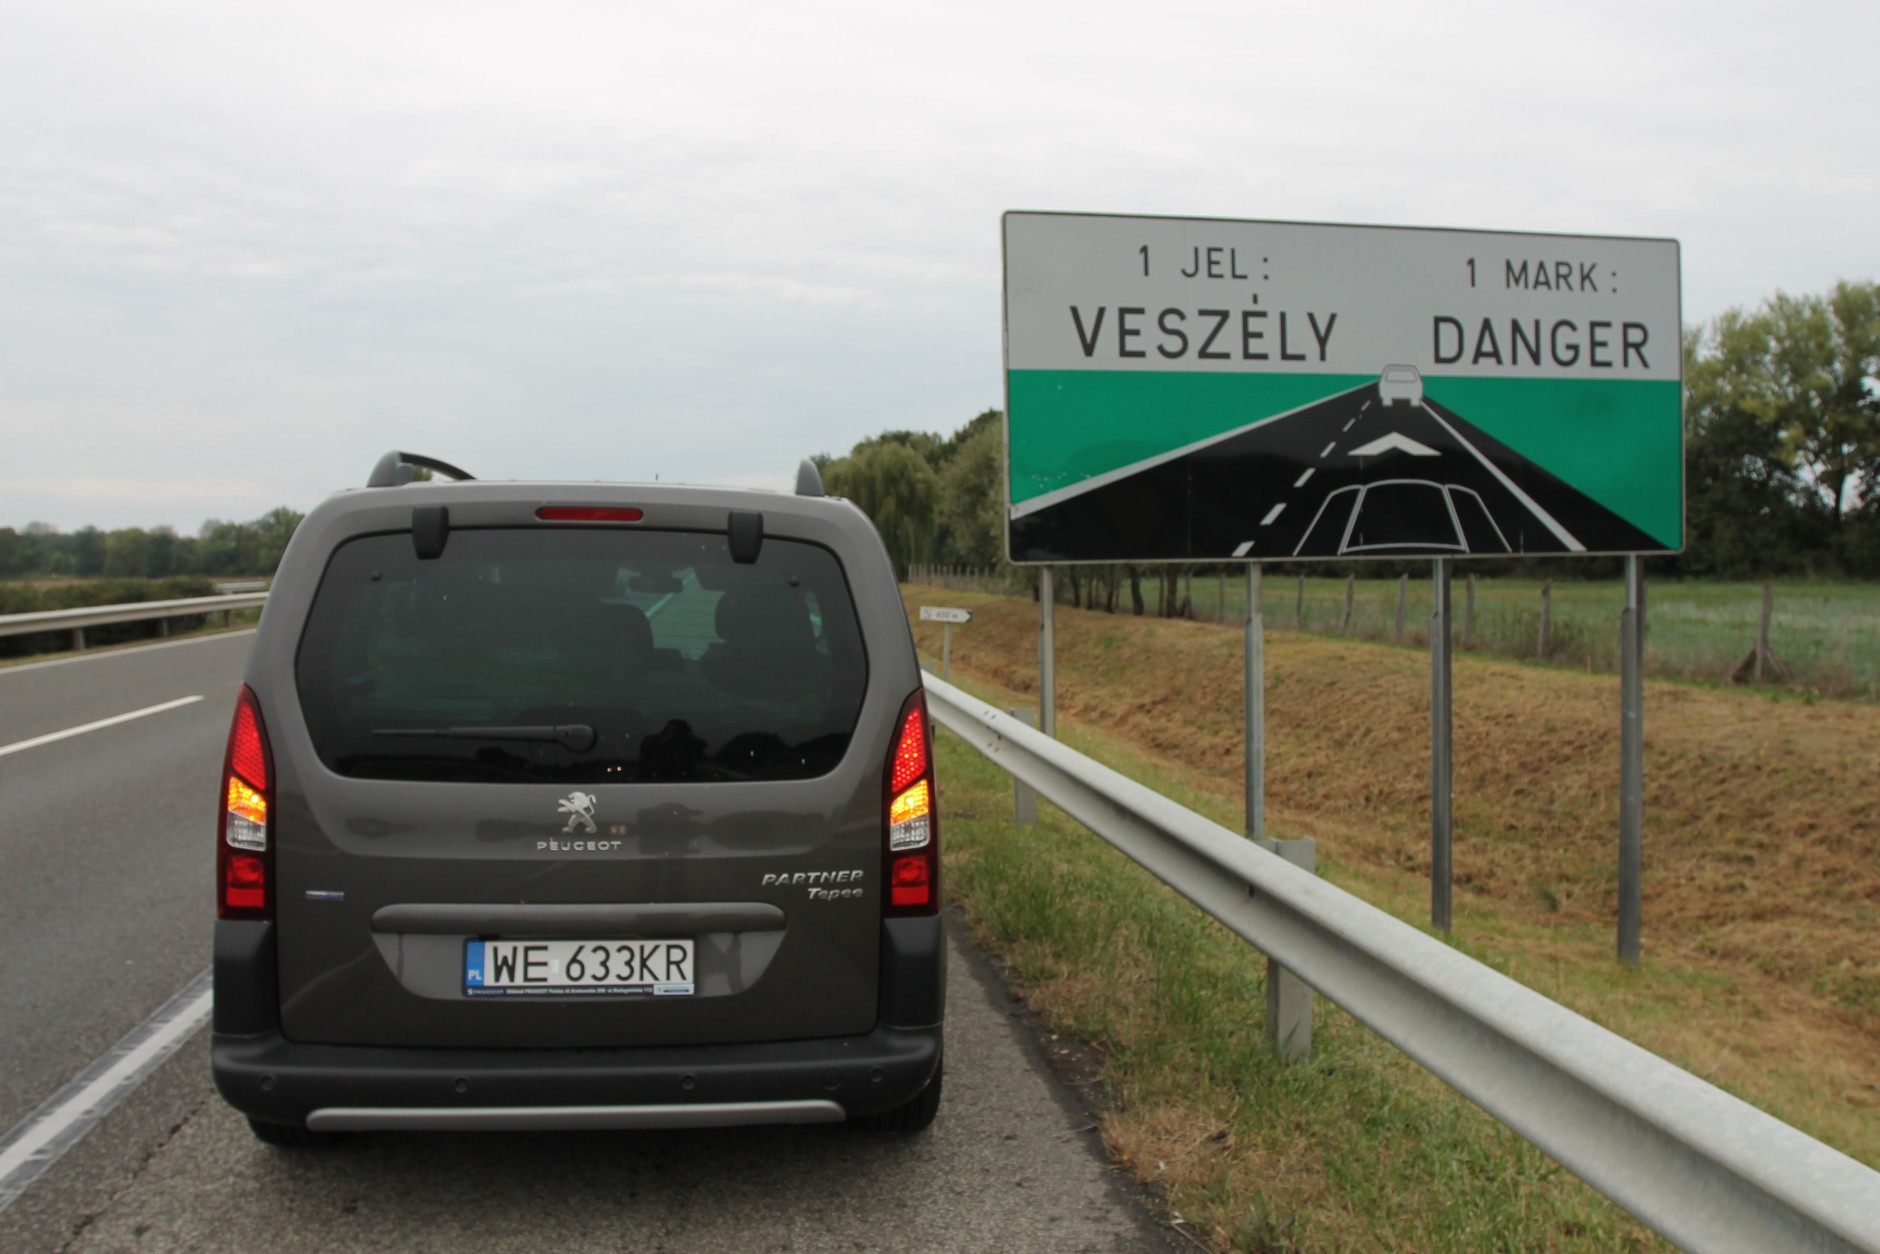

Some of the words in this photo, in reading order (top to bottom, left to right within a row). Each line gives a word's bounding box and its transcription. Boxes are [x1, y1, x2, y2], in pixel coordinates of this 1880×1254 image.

[1138, 244, 1149, 277] 1
[1467, 257, 1476, 288] 1
[1069, 293, 1338, 362] VESZÉLY
[1433, 315, 1650, 369] DANGER
[536, 841, 622, 851] PEUGEOT
[761, 869, 864, 886] PARTNER
[807, 887, 864, 901] Tepee
[468, 969, 482, 981] PL
[492, 944, 549, 983] WE
[565, 944, 688, 983] 633KR
